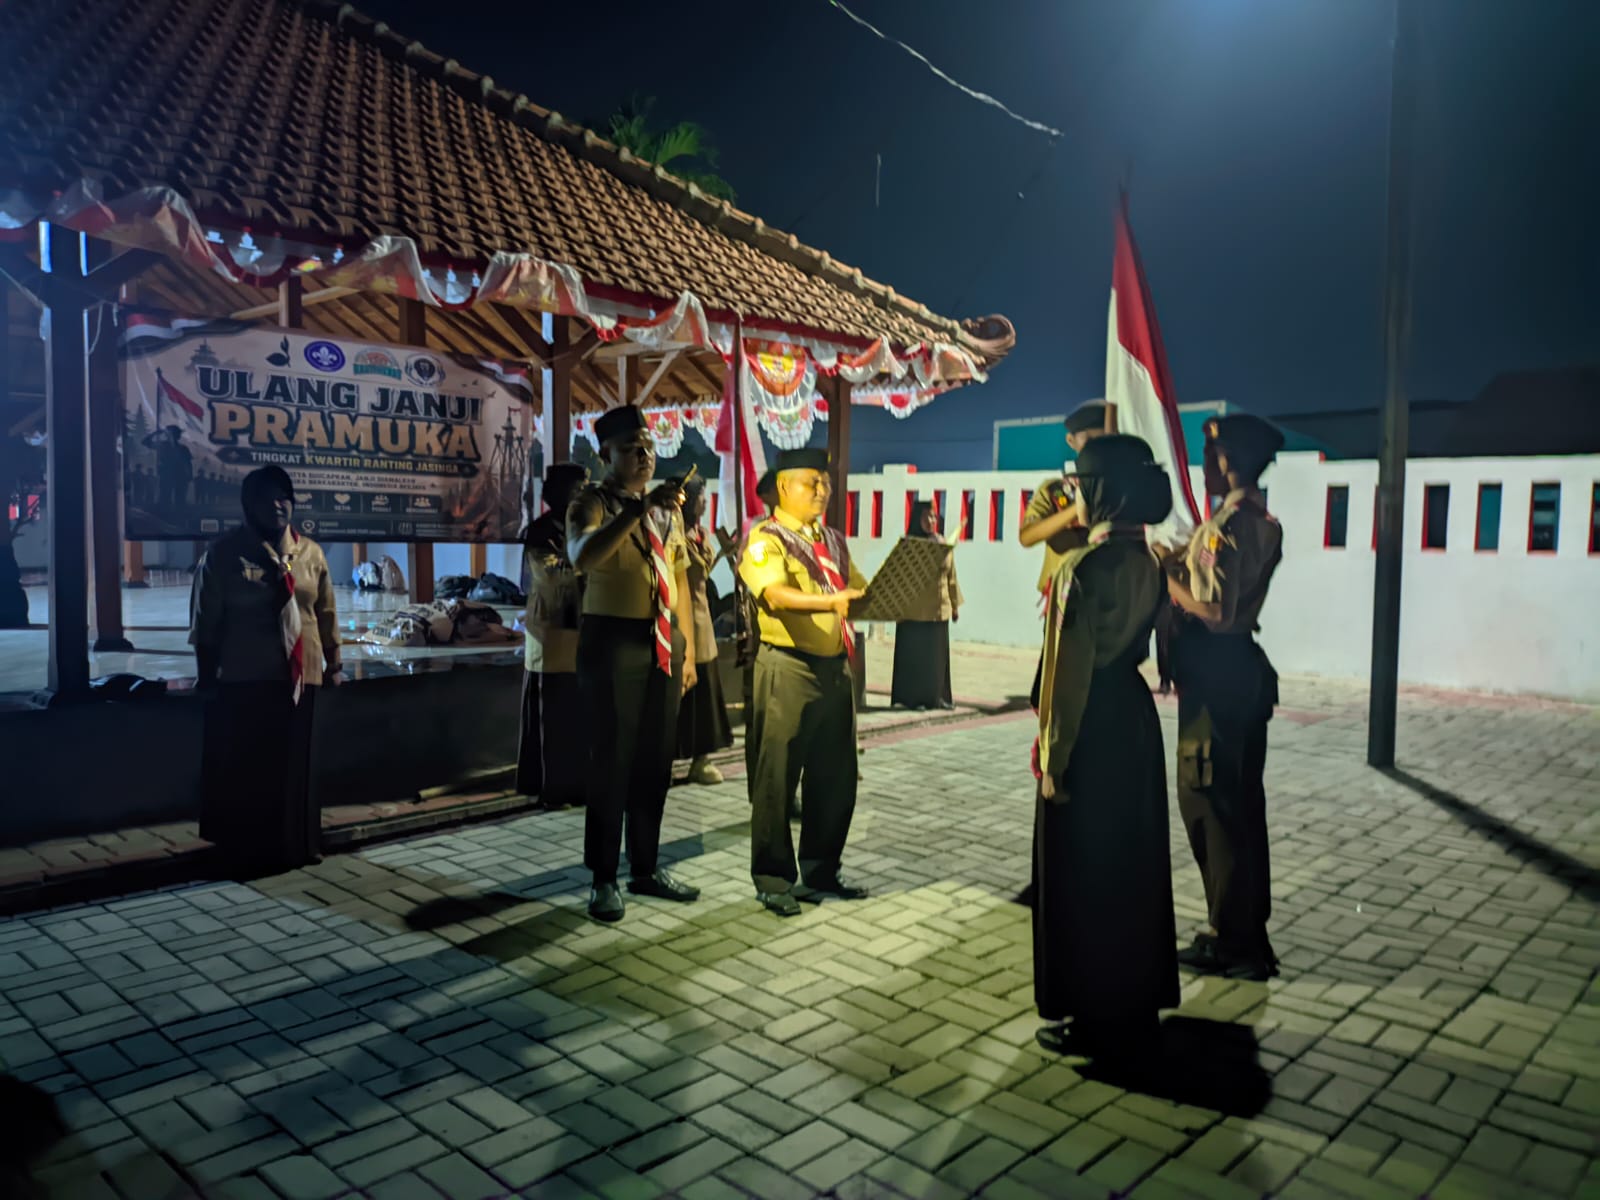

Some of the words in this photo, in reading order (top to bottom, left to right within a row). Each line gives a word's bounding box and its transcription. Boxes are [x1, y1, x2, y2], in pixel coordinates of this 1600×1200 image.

[196, 365, 358, 410] ULANG
[371, 386, 483, 424] JANJI
[209, 401, 480, 460] PRAMUKA
[251, 451, 302, 465] TINGKAT
[304, 454, 361, 468] KWARTIR
[363, 458, 413, 472] RANTING
[415, 461, 459, 474] JASINGA
